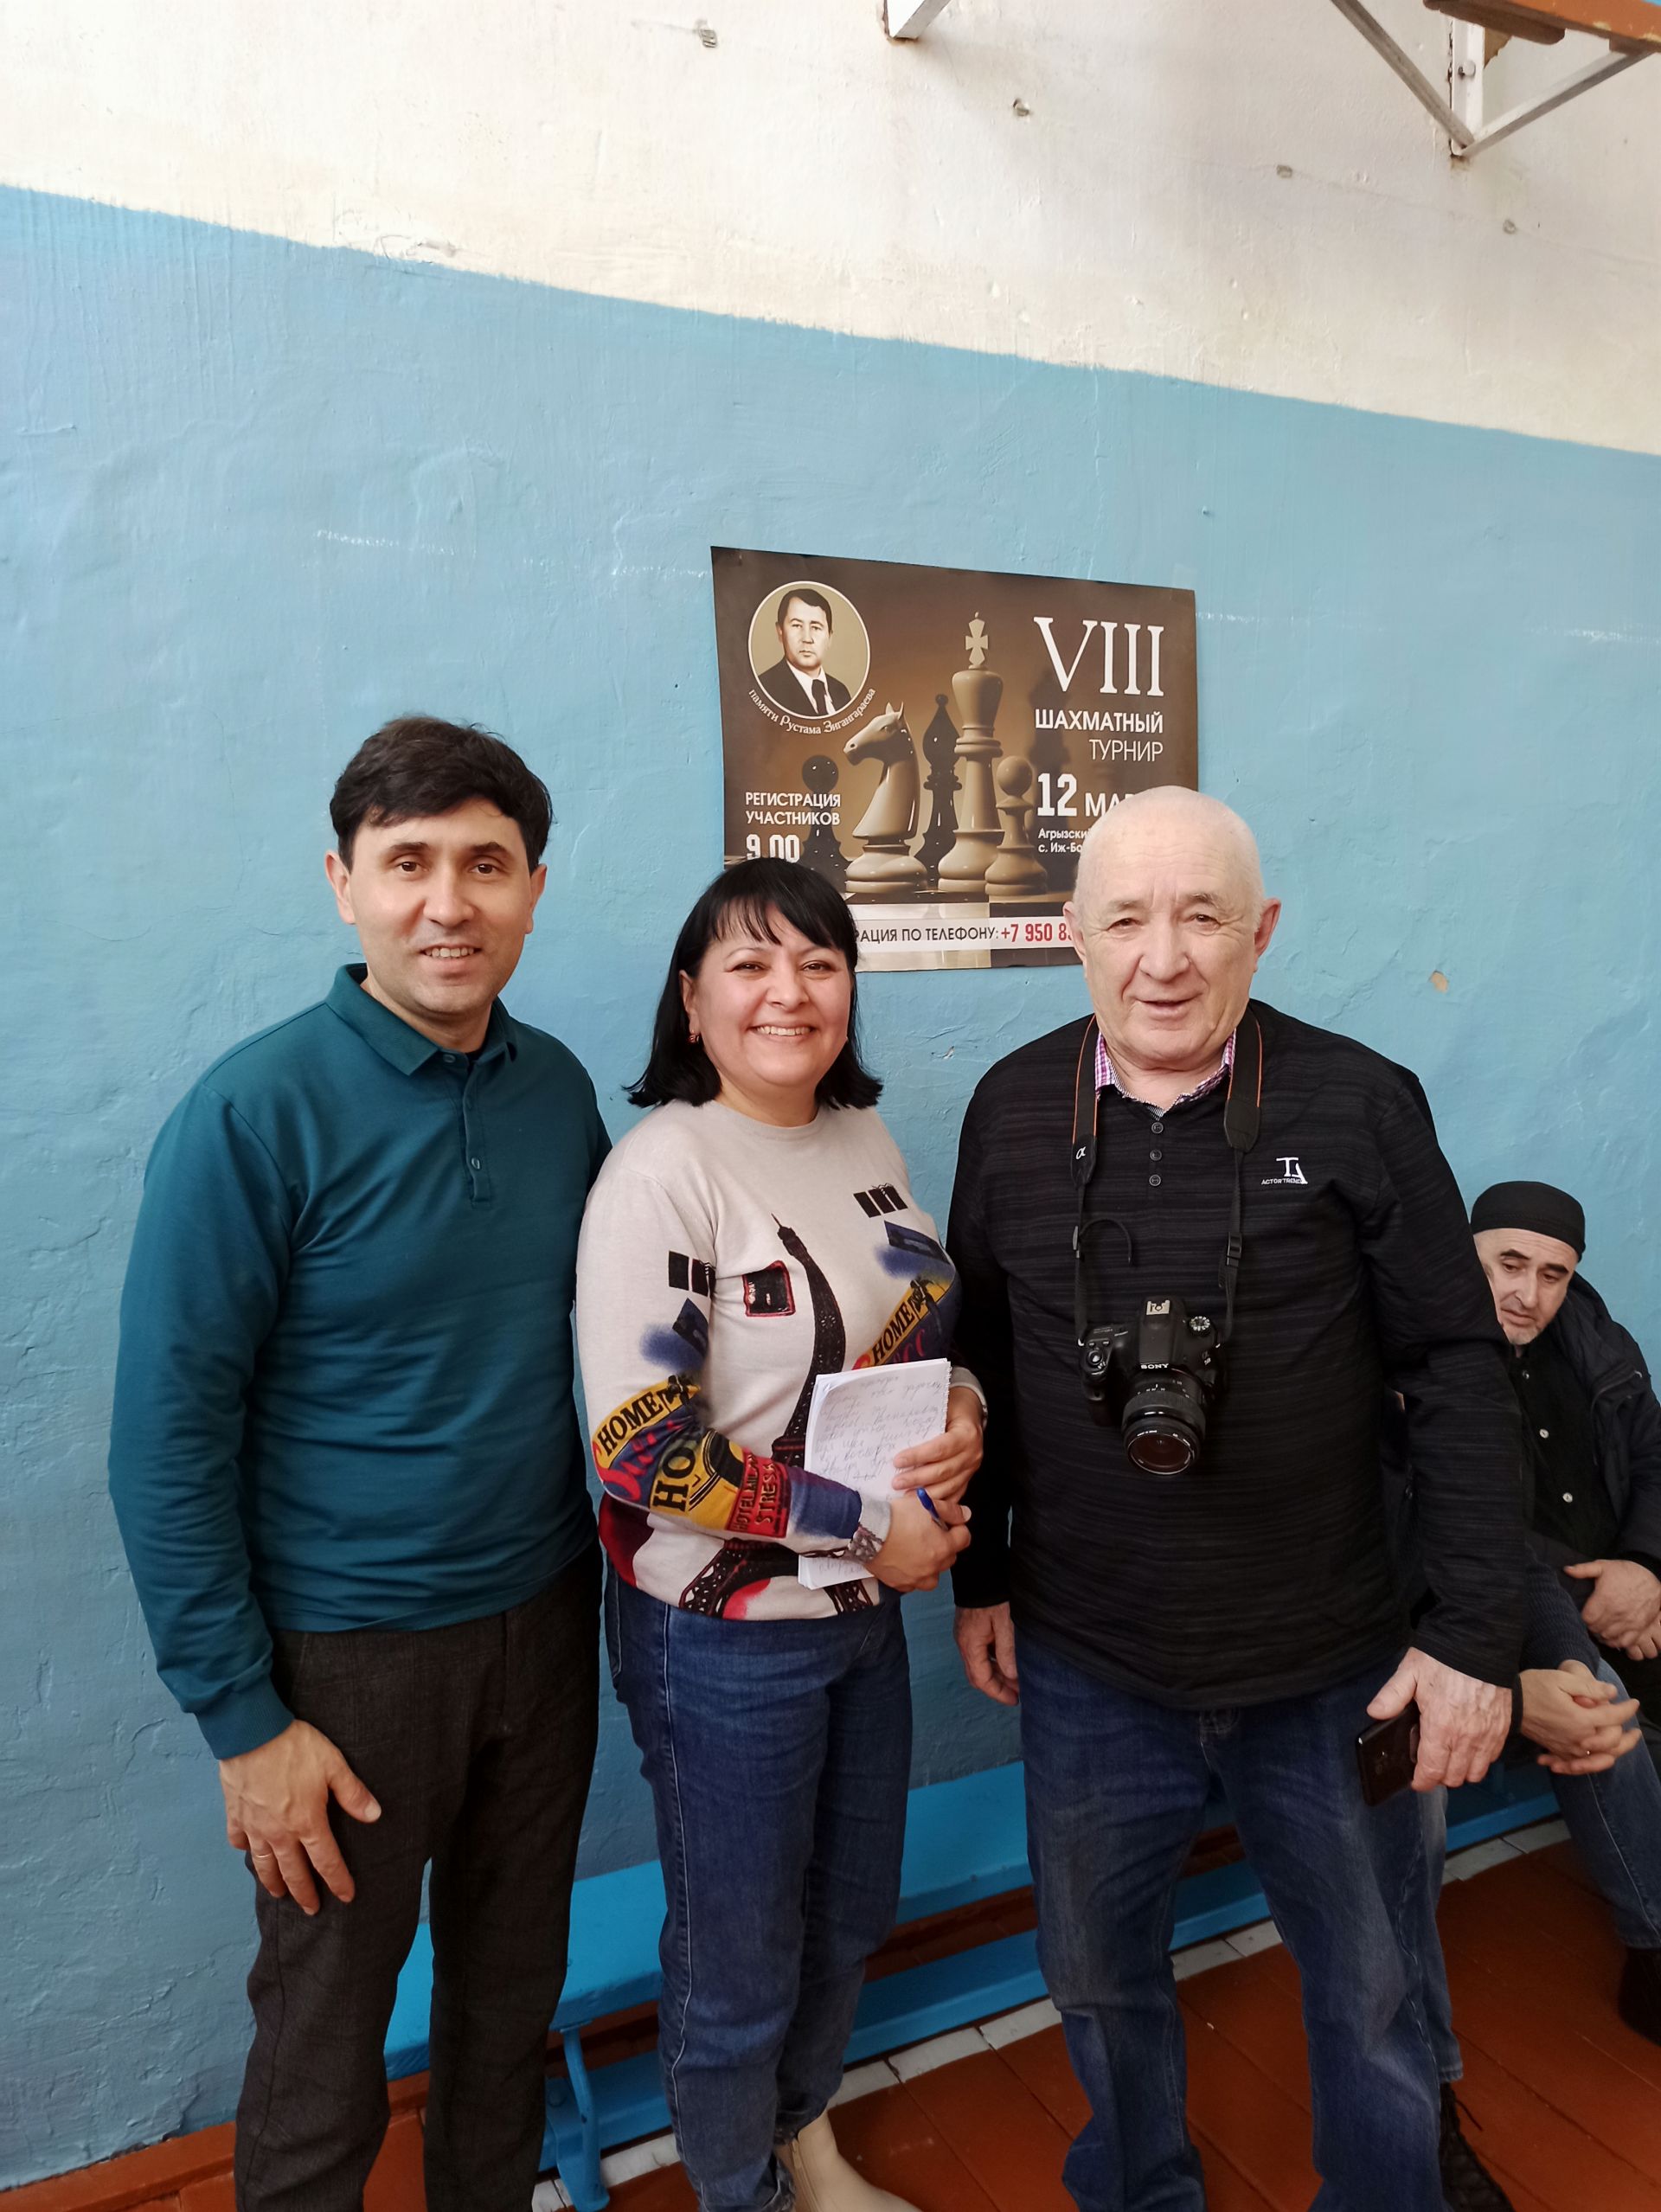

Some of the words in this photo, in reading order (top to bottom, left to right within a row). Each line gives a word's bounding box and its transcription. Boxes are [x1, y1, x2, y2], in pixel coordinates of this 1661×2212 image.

[1033, 617, 1164, 696] VIII
[748, 689, 779, 722] памяти
[779, 715, 822, 734] Рустама
[1035, 708, 1164, 734] ШАХМАТНЫЙ
[1089, 739, 1164, 762] ТУРНИР
[745, 792, 841, 808] РЕГИСТРАЦИЯ
[1037, 773, 1077, 817] 12
[1085, 792, 1135, 817] МА
[745, 811, 840, 825] УЧАСТНИКОВ
[1038, 843, 1049, 853] с.
[901, 927, 922, 941] ПО
[926, 926, 998, 941] ТЕЛЕФОНУ:
[1001, 924, 1019, 943] +7
[1025, 923, 1053, 941] 950
[1058, 923, 1073, 941] 8
[872, 1301, 915, 1364] HOME
[597, 1390, 664, 1457] HOME
